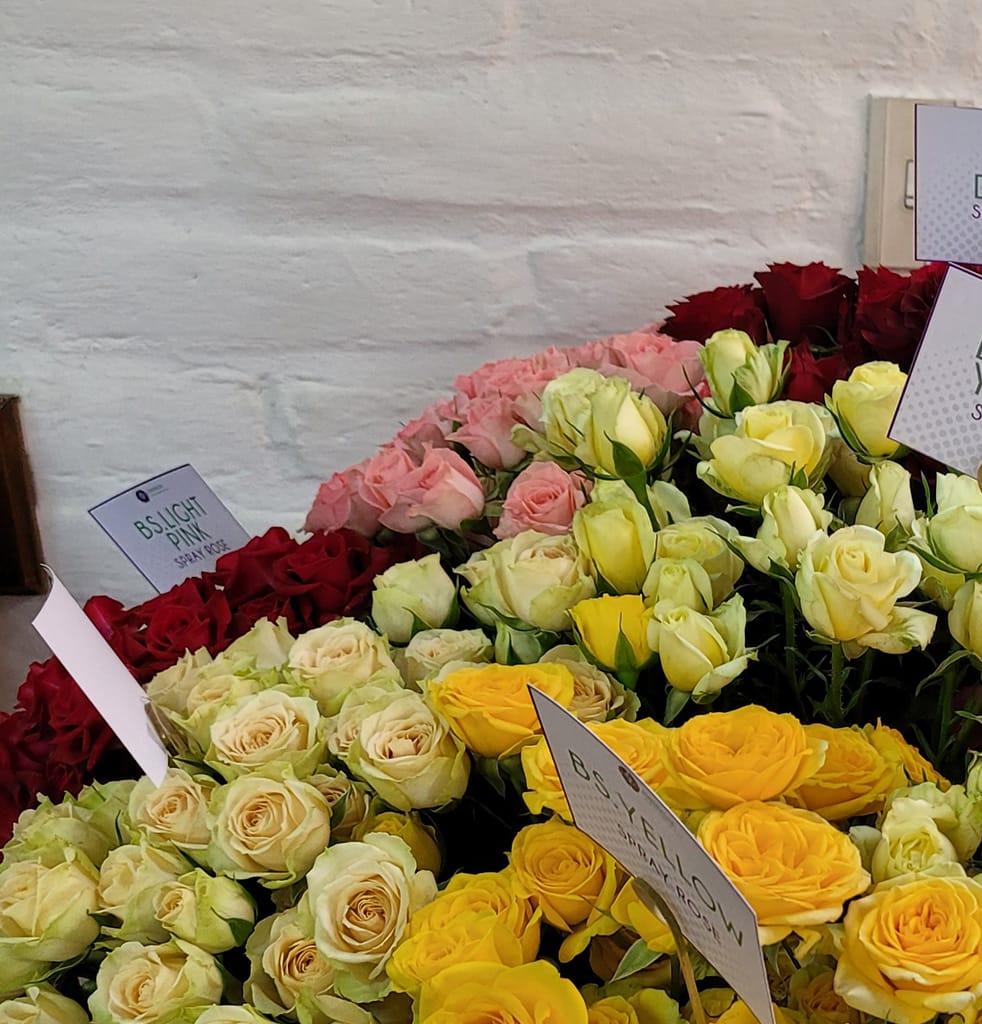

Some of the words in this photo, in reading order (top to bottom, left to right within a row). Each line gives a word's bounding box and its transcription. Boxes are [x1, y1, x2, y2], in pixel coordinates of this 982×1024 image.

[134, 496, 207, 539] BS.LIGHT
[166, 522, 212, 551] PINK
[173, 547, 207, 569] SPRAY
[203, 539, 231, 557] ROSE
[616, 822, 670, 883] SPRAY
[675, 884, 722, 946] ROSE
